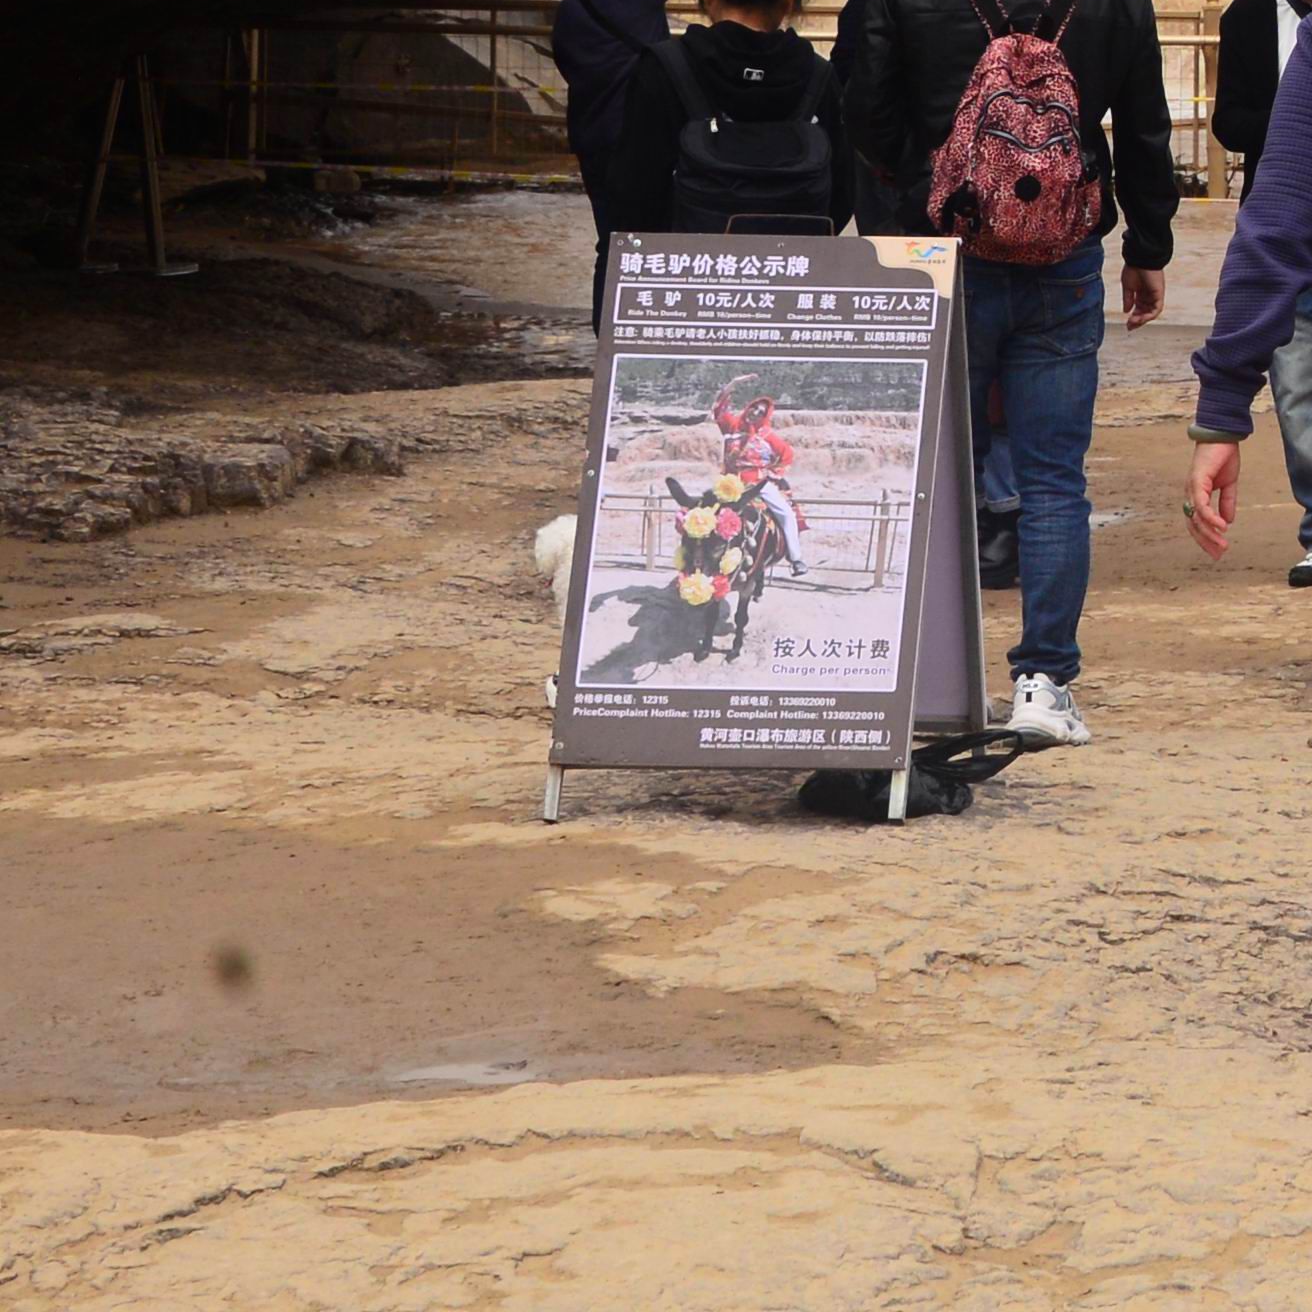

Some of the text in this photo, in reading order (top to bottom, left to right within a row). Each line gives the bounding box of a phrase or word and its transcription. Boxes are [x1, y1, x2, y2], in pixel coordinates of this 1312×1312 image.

[620, 252, 810, 277] 骑毛驴价格公示牌
[696, 292, 776, 309] 10元/人次
[797, 293, 837, 310] 服装
[852, 295, 931, 311] 10元/人次
[773, 638, 891, 660] 按人次计费
[772, 664, 816, 676] Charge
[819, 666, 840, 676] per
[693, 710, 721, 718] 12315
[727, 710, 777, 721] Complaint
